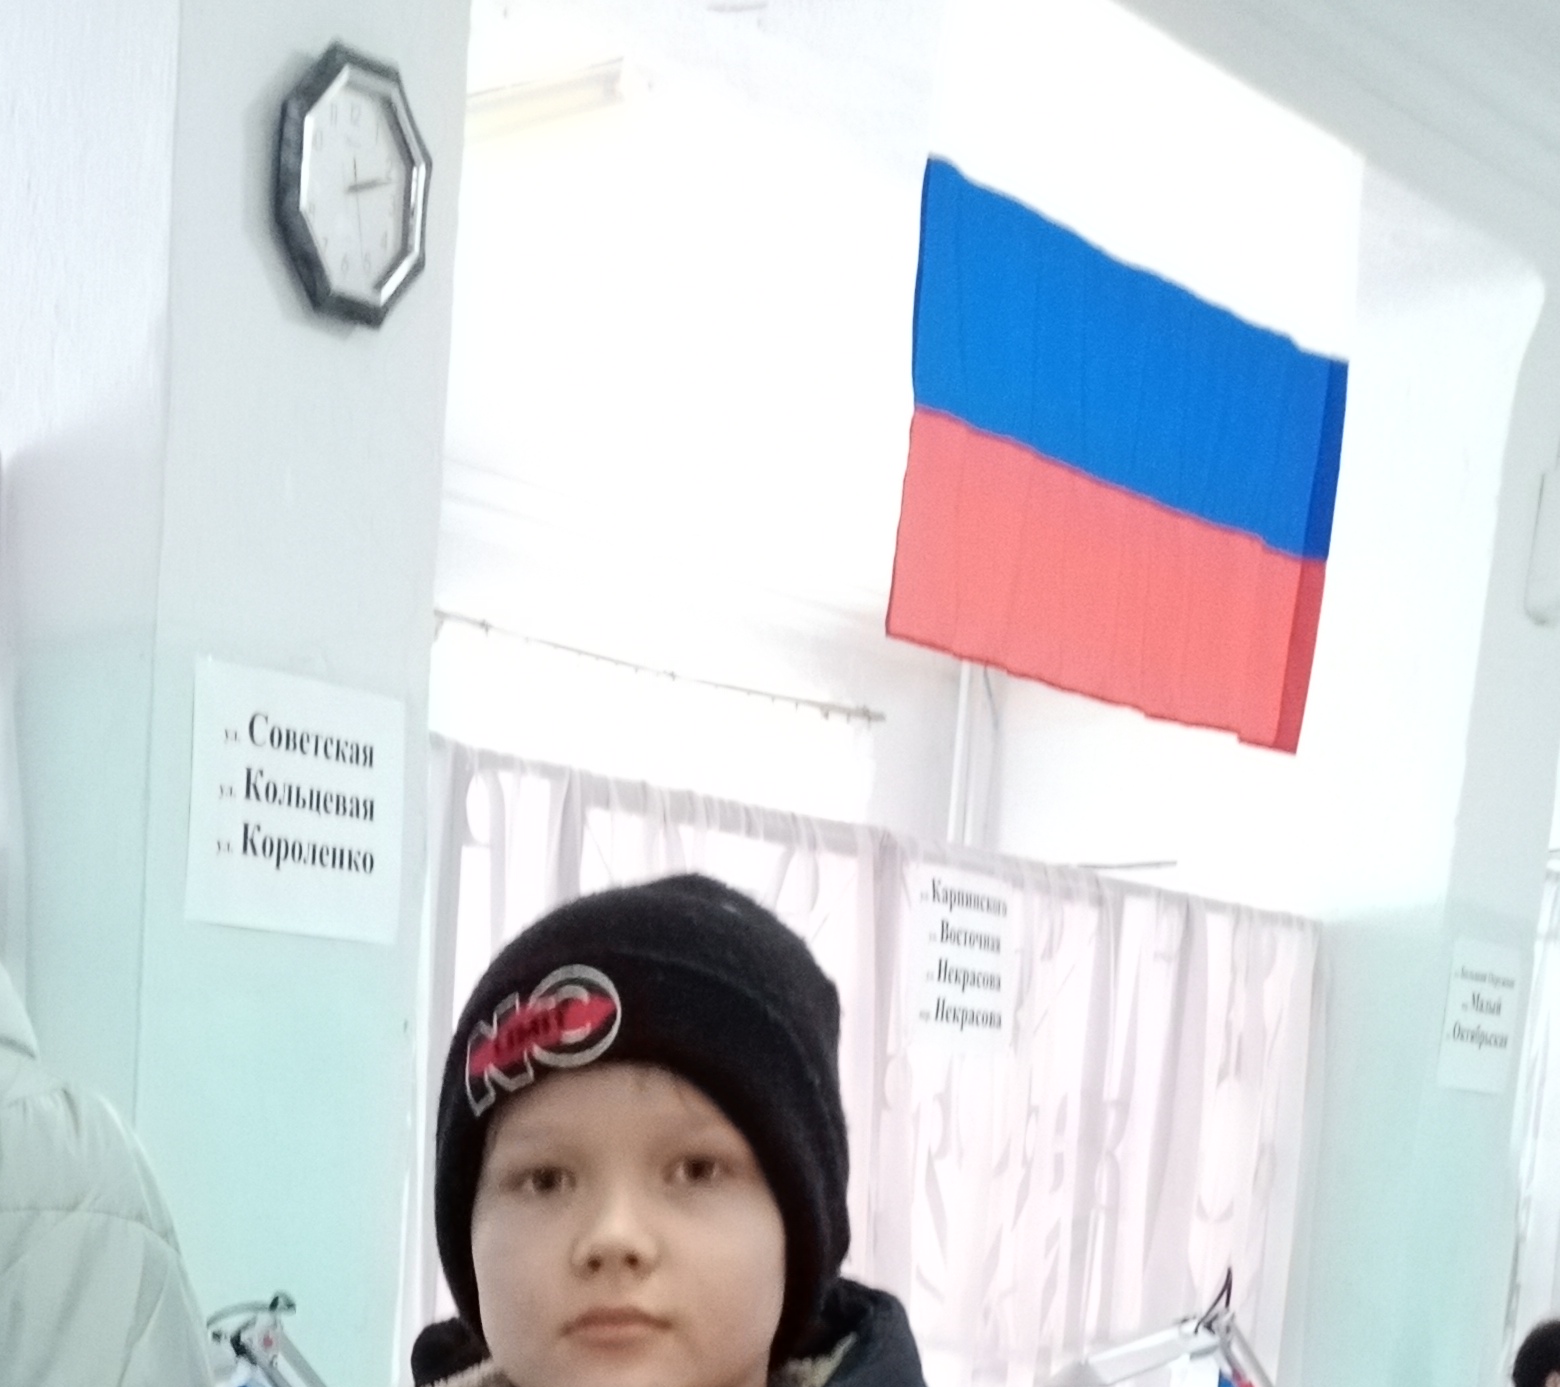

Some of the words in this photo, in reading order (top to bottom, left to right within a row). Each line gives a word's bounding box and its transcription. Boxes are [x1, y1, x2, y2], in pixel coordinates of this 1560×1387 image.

[248, 711, 375, 769] Советская
[244, 766, 375, 822] Кольцевая
[241, 821, 375, 875] Короленко
[940, 918, 1001, 955] Восточная
[937, 957, 1001, 994] Некрасова
[934, 996, 1002, 1032] Некрасова
